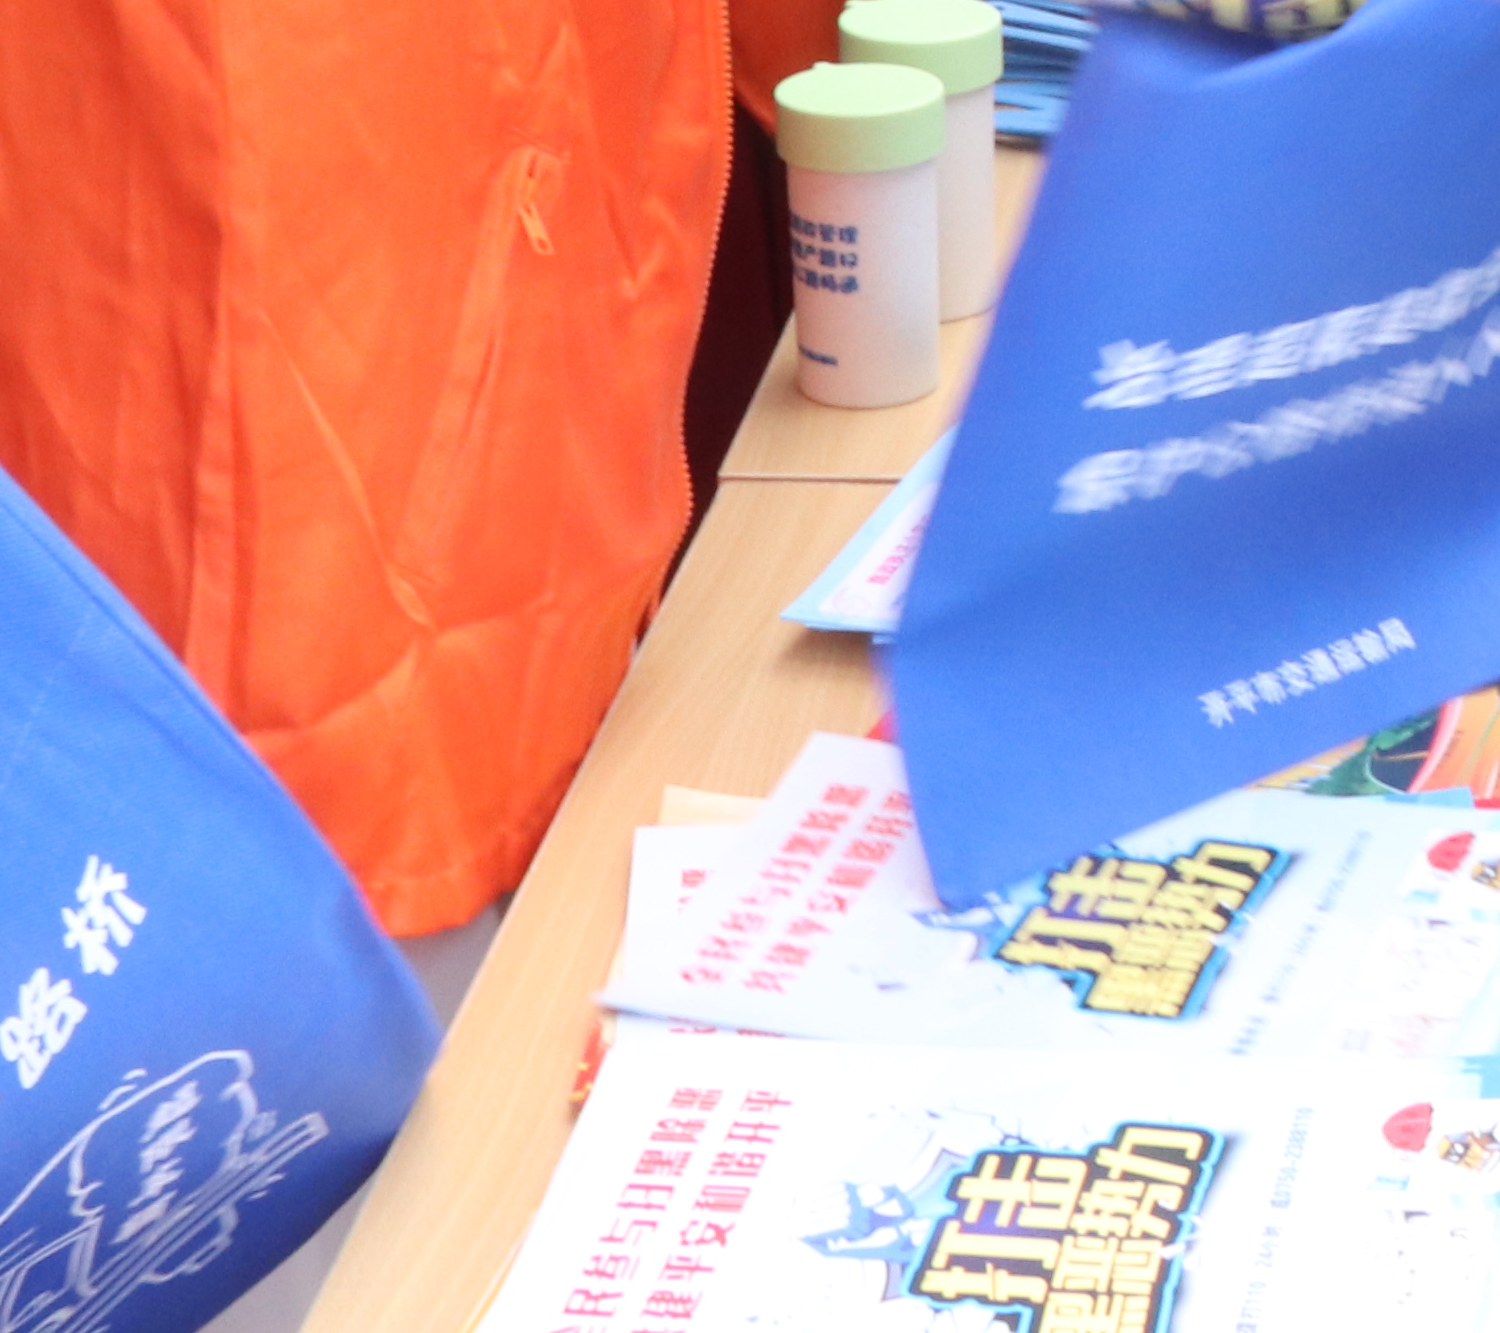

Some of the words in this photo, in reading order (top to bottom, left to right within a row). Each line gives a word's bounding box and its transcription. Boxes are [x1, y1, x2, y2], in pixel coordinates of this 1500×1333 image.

[631, 1089, 793, 1333] 建平安和谐开平
[920, 1153, 1088, 1304] 打击
